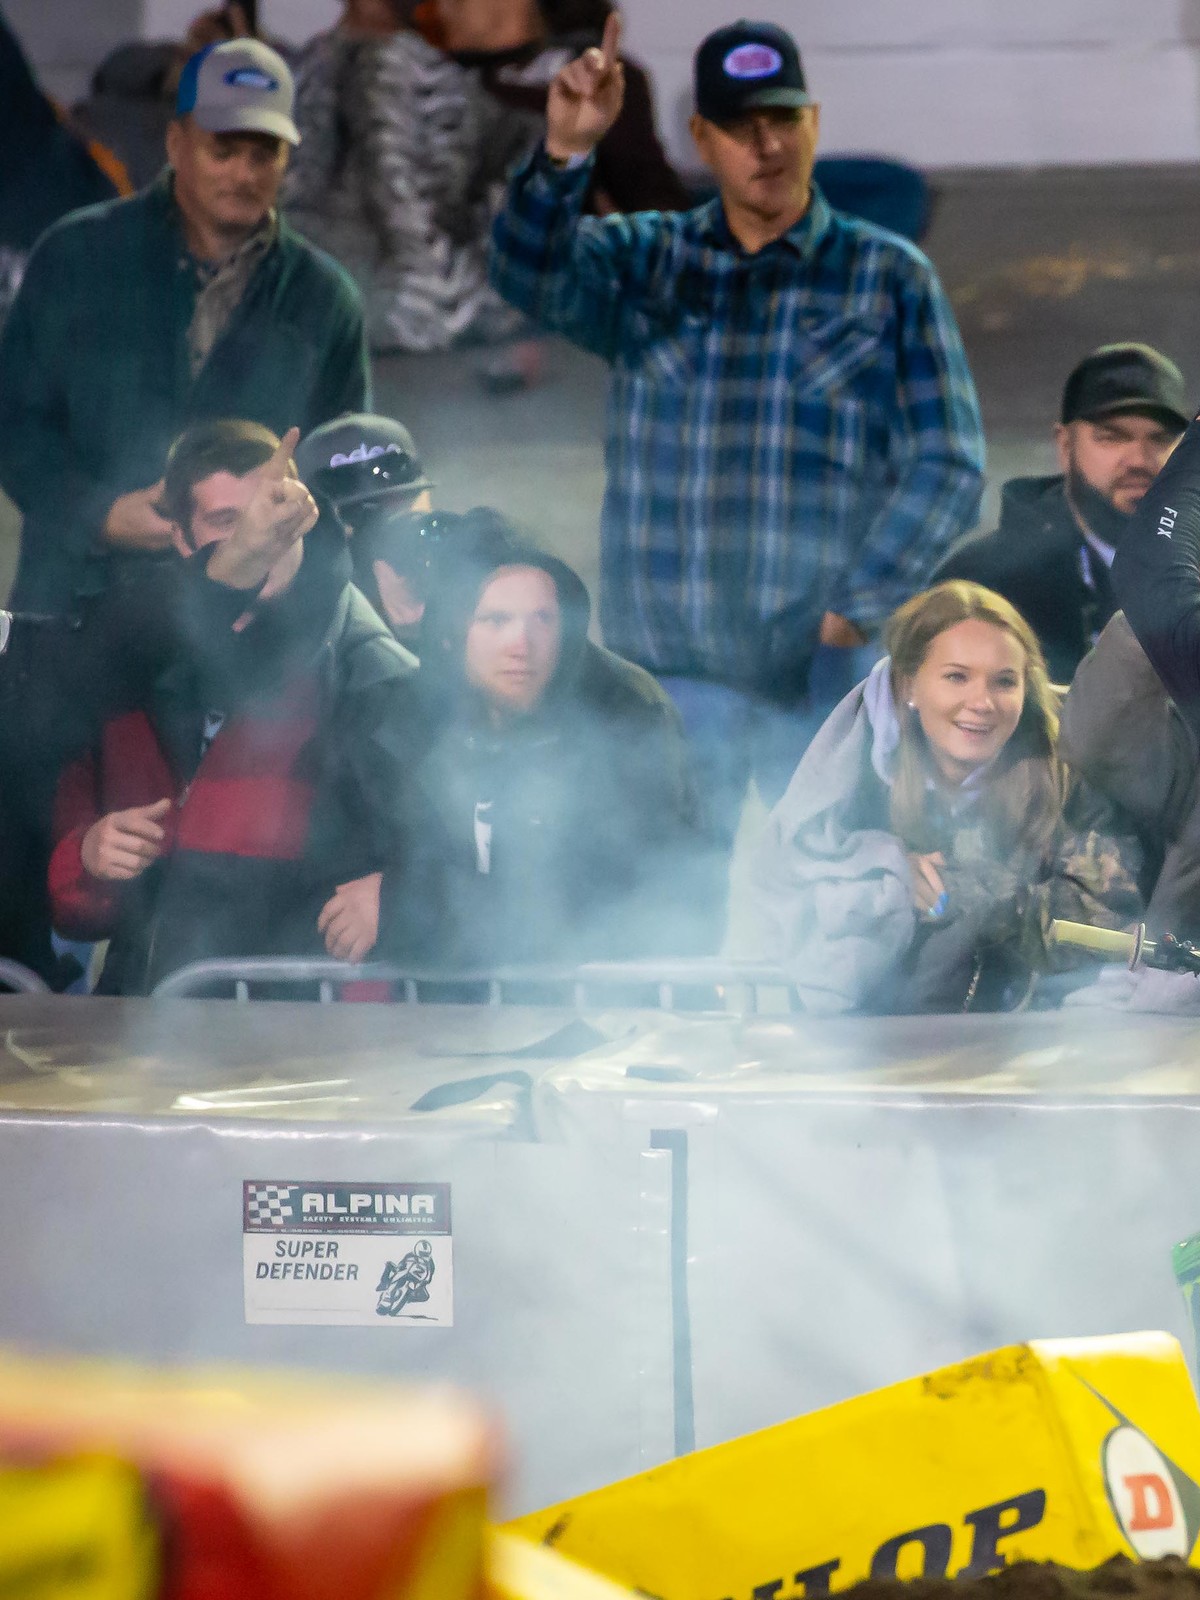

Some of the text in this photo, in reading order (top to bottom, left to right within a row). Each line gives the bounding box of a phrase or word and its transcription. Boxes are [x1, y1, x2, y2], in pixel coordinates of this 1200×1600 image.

[1157, 506, 1178, 539] FOX
[302, 1193, 434, 1214] ALPINA
[275, 1240, 339, 1259] SUPER
[256, 1262, 359, 1281] DEFENDER
[1123, 1473, 1175, 1532] D
